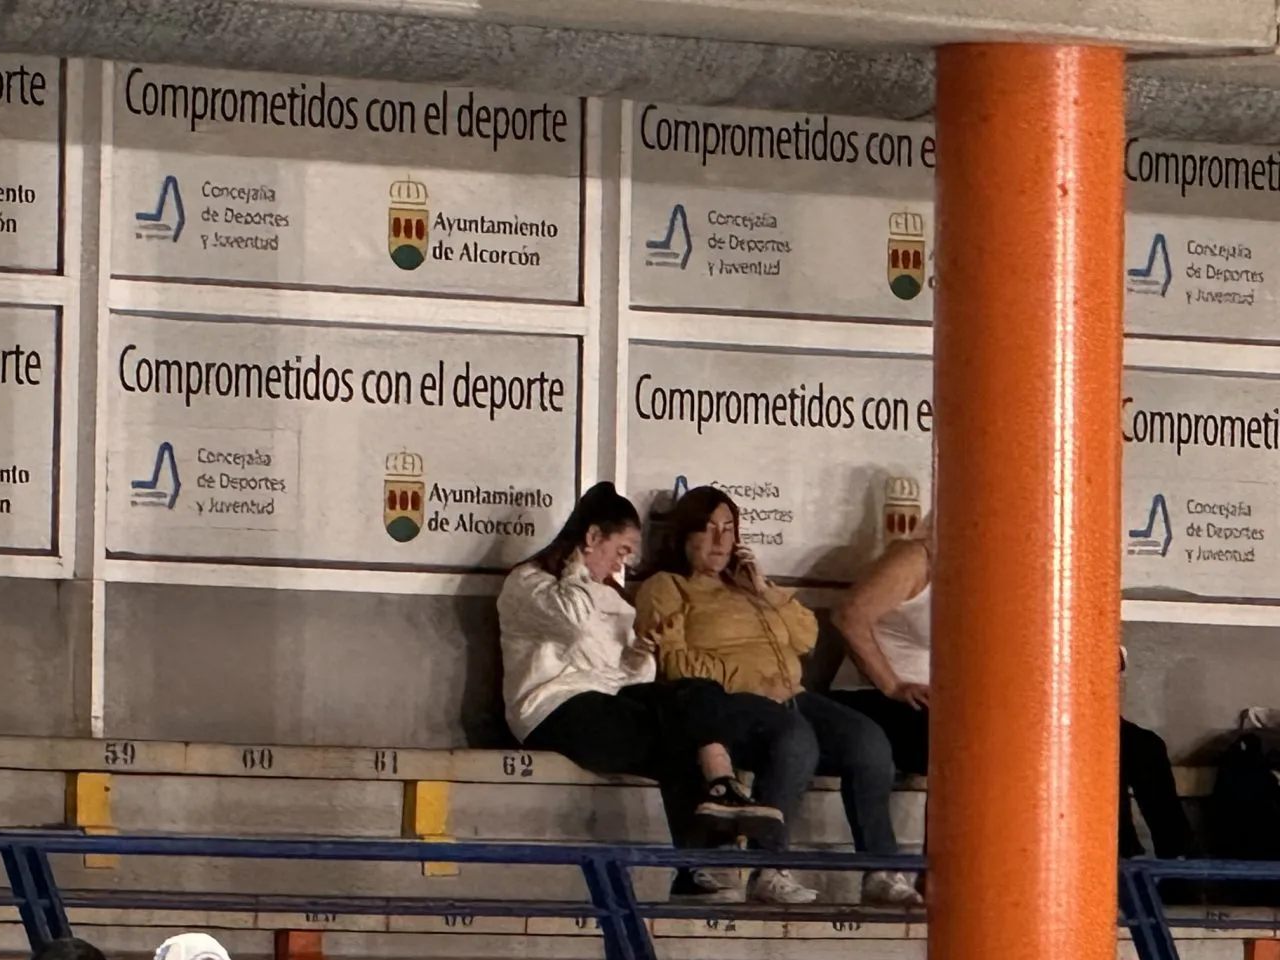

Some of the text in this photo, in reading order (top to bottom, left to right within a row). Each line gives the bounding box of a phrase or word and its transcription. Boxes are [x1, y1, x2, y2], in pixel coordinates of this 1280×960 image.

[126, 68, 567, 151] Comprometidos con el deporte
[641, 104, 936, 168] Comprometidos con e
[201, 207, 289, 228] de Deportes
[433, 212, 558, 238] Ayuntamiento
[432, 240, 540, 266] de Alcorcón
[119, 344, 564, 421] Comprometidos con el deporte
[635, 374, 933, 435] Comprometidos con e
[220, 474, 286, 493] Deportes
[429, 483, 552, 509] Ayuntamiento
[427, 511, 535, 537] de Alcorcón
[105, 742, 136, 765] 59
[503, 754, 533, 777] 62
